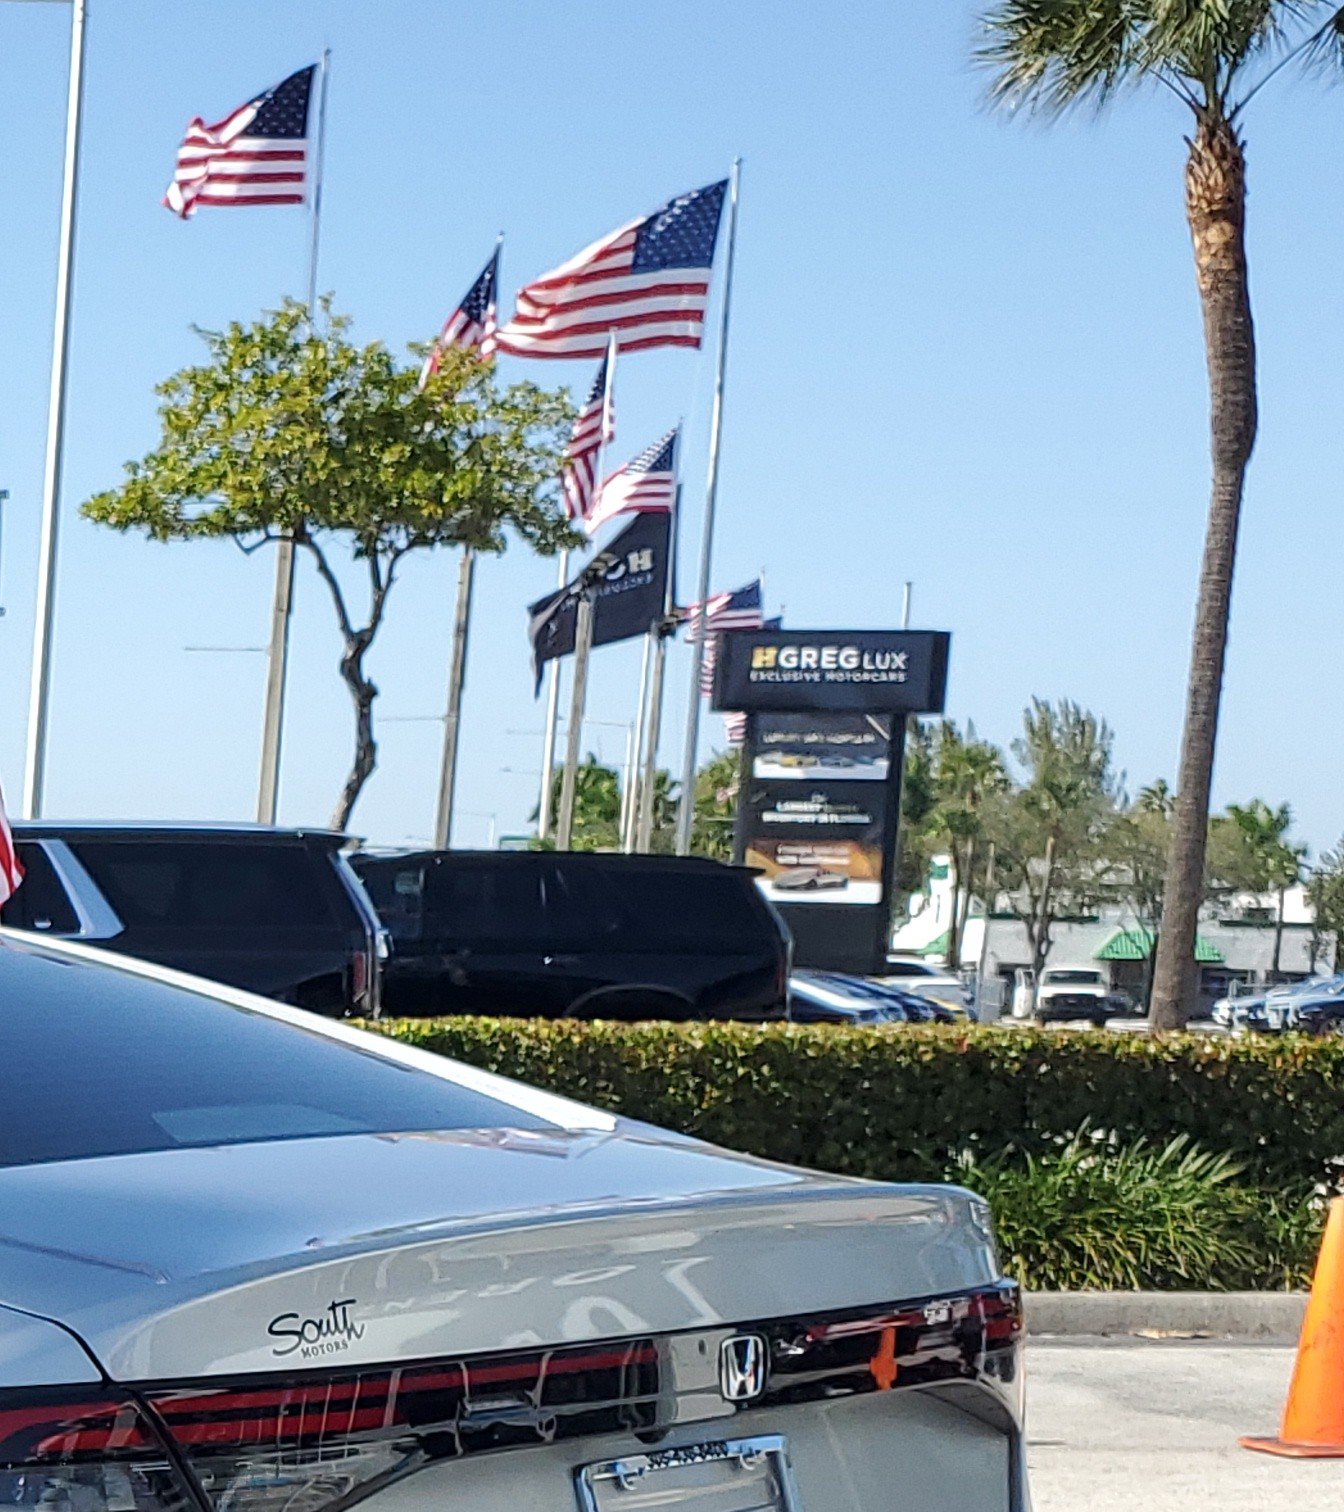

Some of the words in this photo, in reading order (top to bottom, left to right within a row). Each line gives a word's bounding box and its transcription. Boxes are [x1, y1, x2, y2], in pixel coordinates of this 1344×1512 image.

[863, 650, 910, 670] LUX
[268, 1299, 365, 1356] South
[301, 1339, 349, 1358] MOTORS
